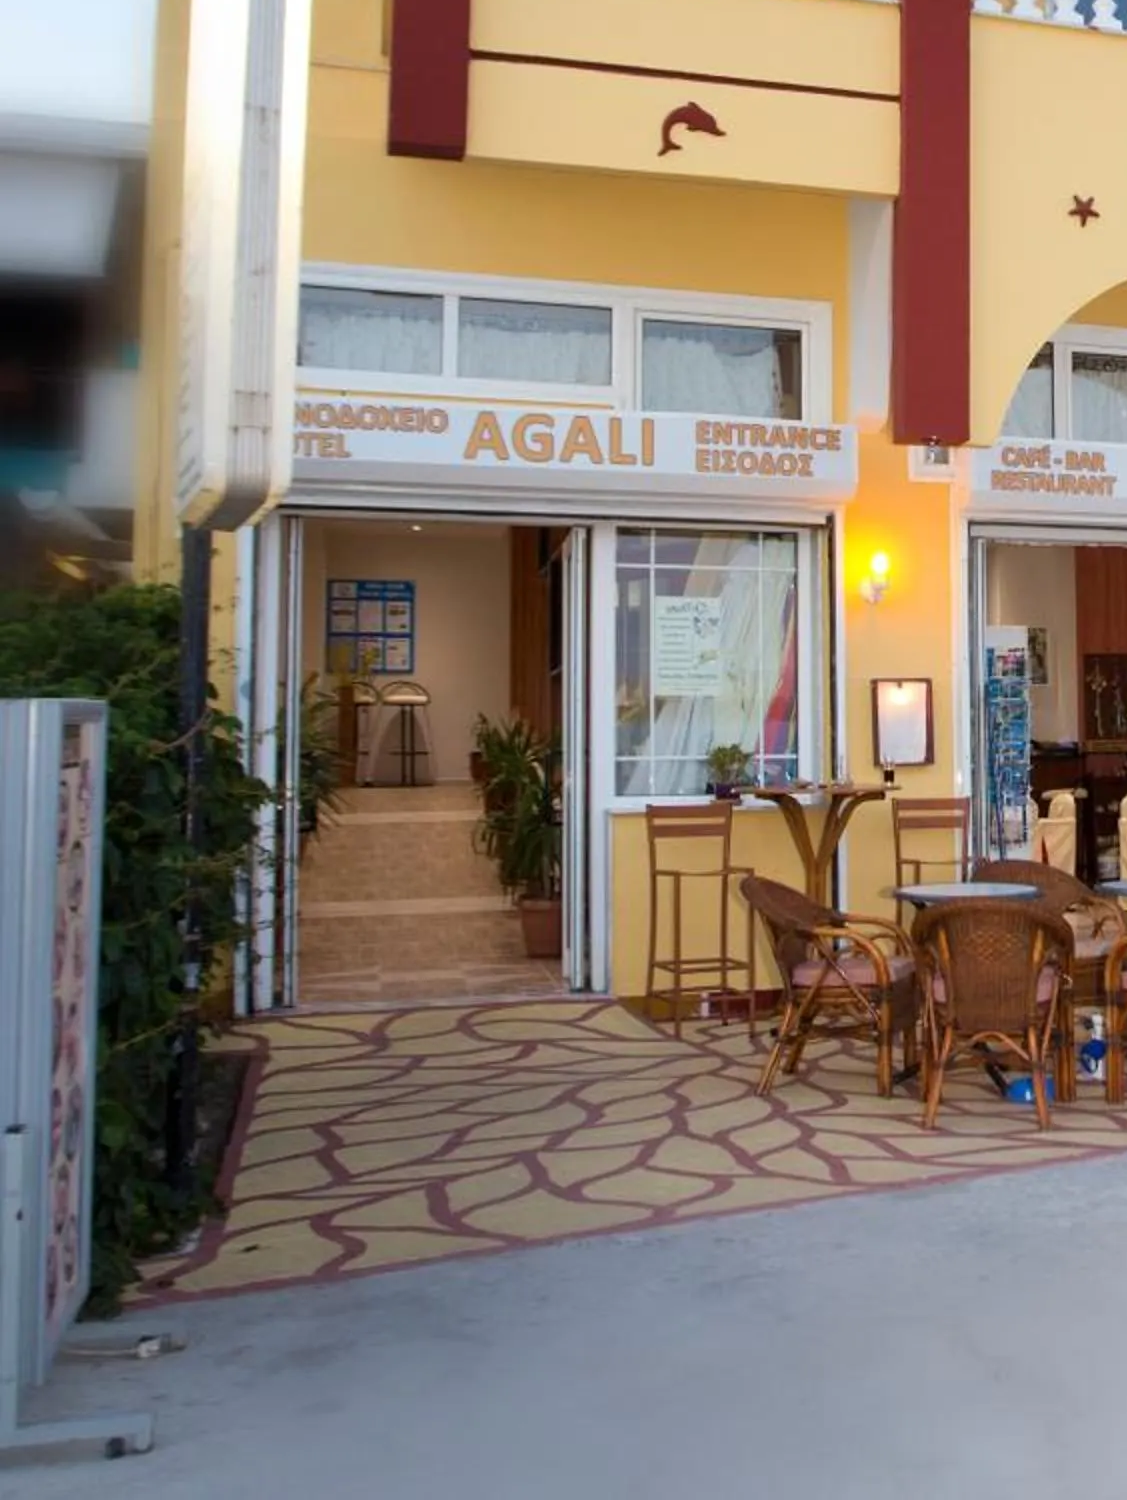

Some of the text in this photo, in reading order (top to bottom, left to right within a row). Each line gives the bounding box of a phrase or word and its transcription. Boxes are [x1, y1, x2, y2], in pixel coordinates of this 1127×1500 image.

[295, 402, 449, 434] ΝΟΔΟΧΕΙΟ
[294, 431, 352, 459] TEL
[463, 410, 655, 466] AGALI
[695, 419, 842, 452] ENTRANCE
[695, 449, 815, 477] ΕΙΣΟΔΟΣ
[1065, 449, 1106, 473] BAR
[991, 470, 1118, 497] RESTAURANT
